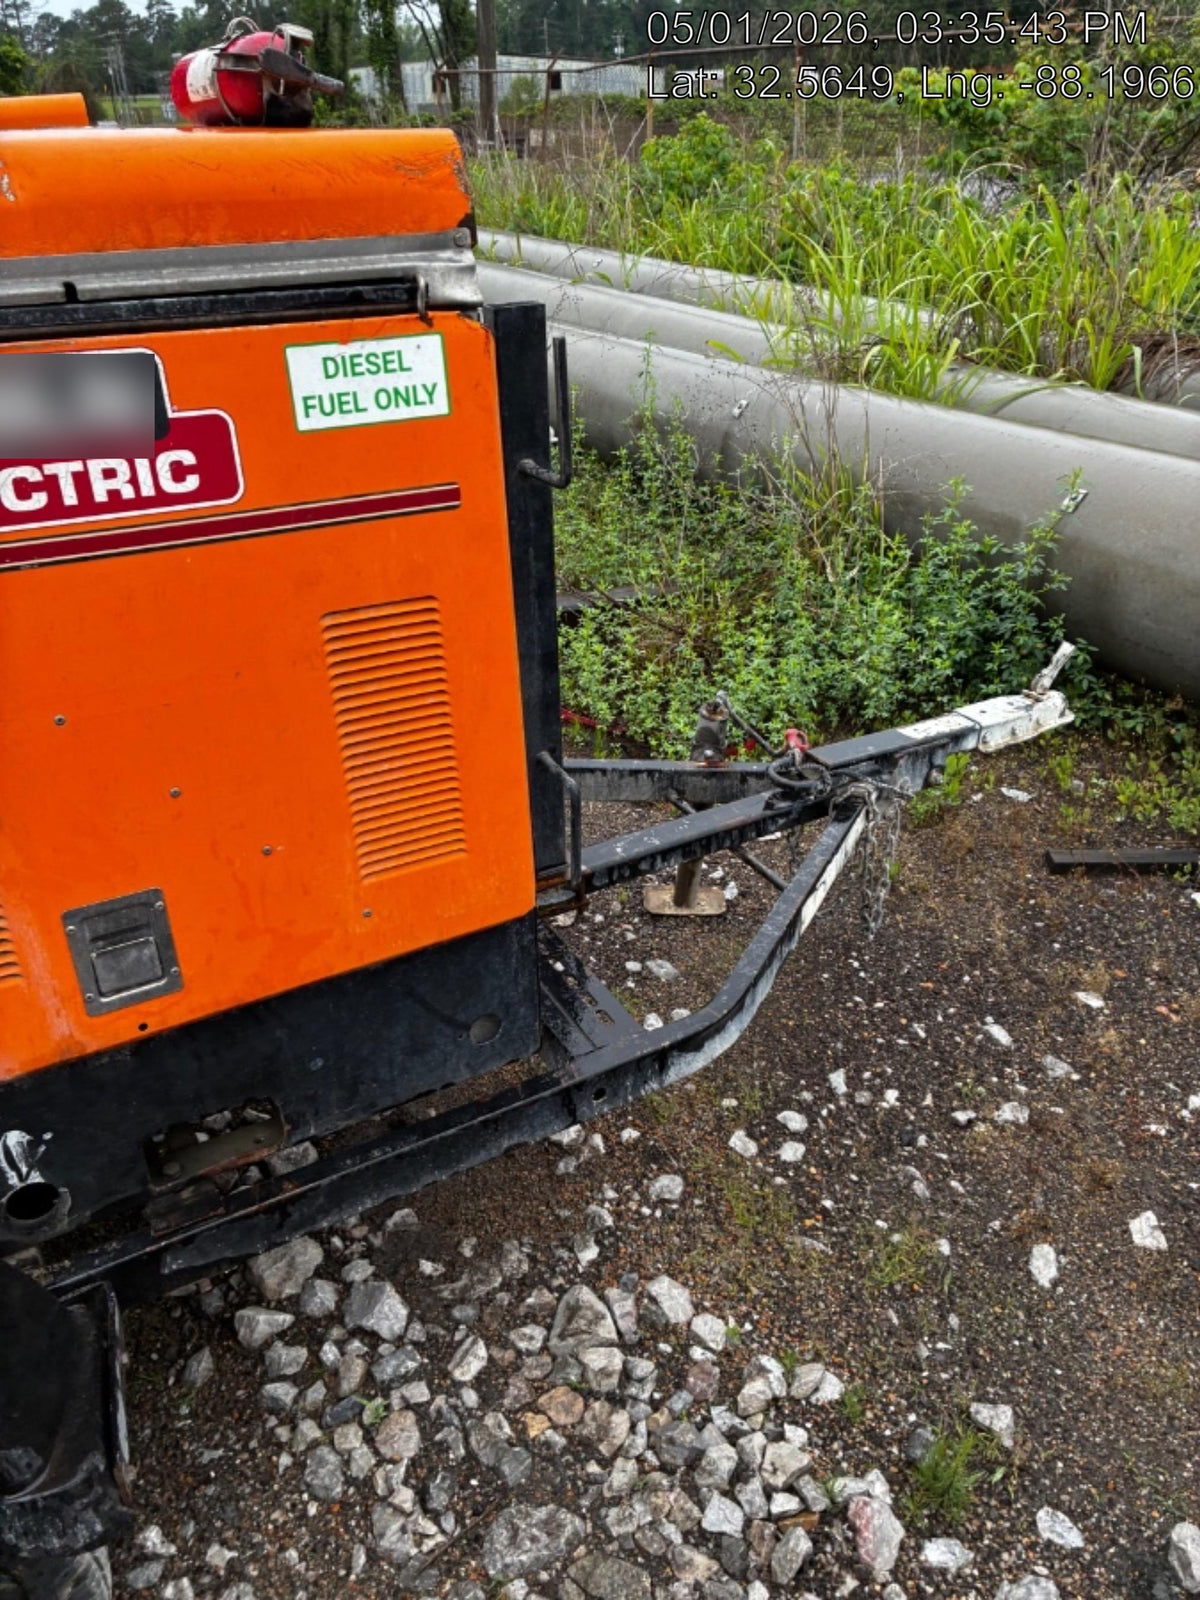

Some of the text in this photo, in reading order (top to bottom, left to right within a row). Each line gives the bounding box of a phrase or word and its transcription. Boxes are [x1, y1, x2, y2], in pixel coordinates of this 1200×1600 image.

[322, 350, 412, 380] DIESEL
[302, 382, 438, 419] FUEL ONLY
